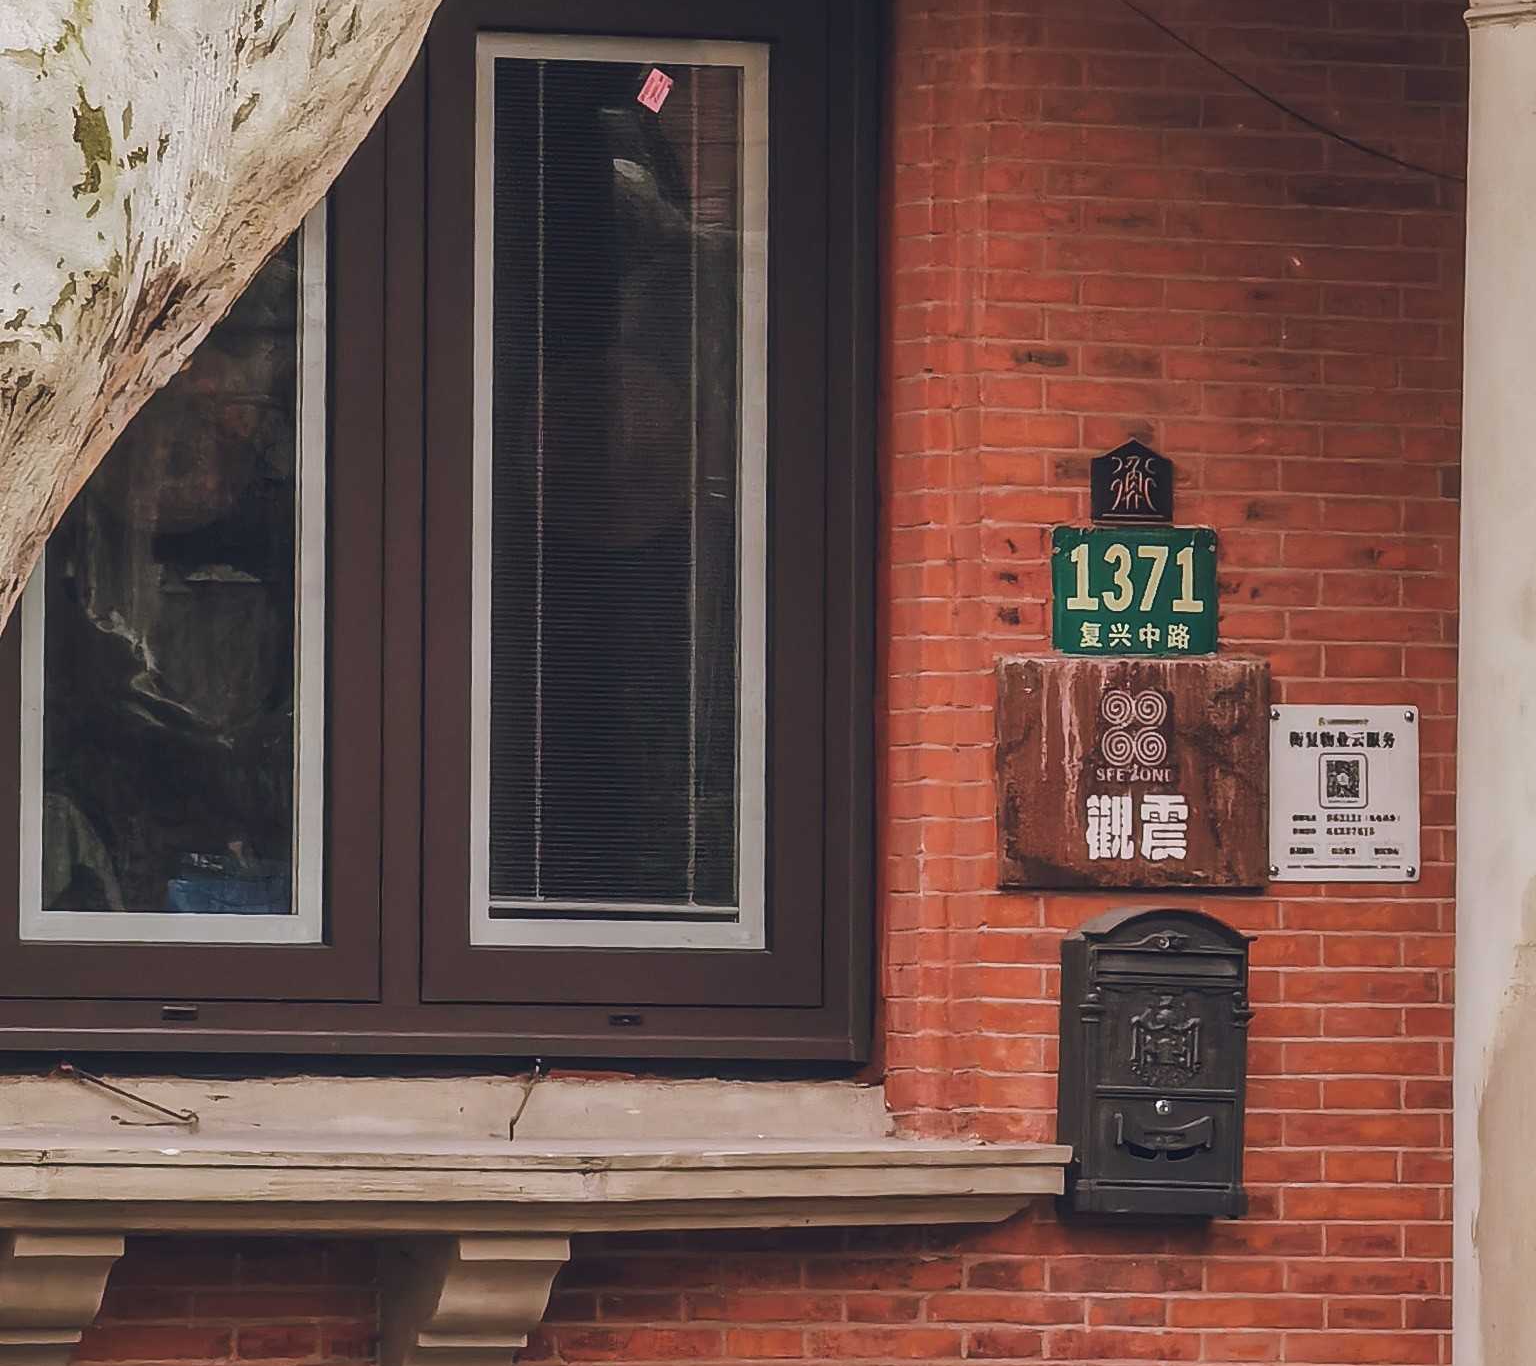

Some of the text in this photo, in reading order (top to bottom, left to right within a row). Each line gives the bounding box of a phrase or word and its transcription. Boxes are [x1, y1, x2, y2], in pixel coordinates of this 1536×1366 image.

[1066, 543, 1204, 613] 1371
[1079, 621, 1191, 649] 复兴中路
